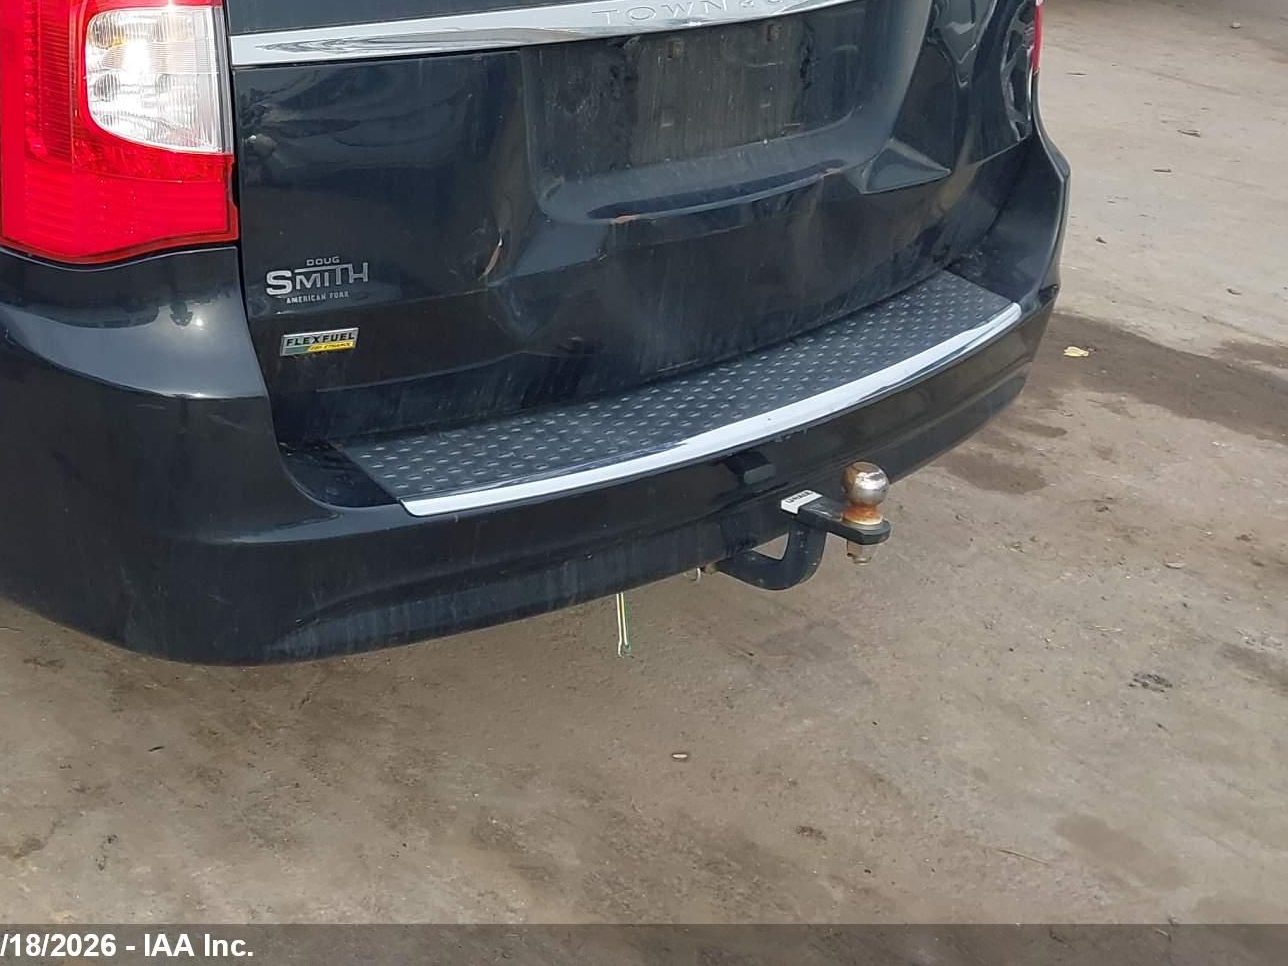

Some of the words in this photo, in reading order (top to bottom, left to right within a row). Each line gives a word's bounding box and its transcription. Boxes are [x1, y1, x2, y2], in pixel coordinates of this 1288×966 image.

[306, 255, 340, 266] DOUG
[265, 261, 369, 296] SMITH
[286, 292, 327, 304] AMERICAN
[286, 332, 355, 346] FLEXFUEL
